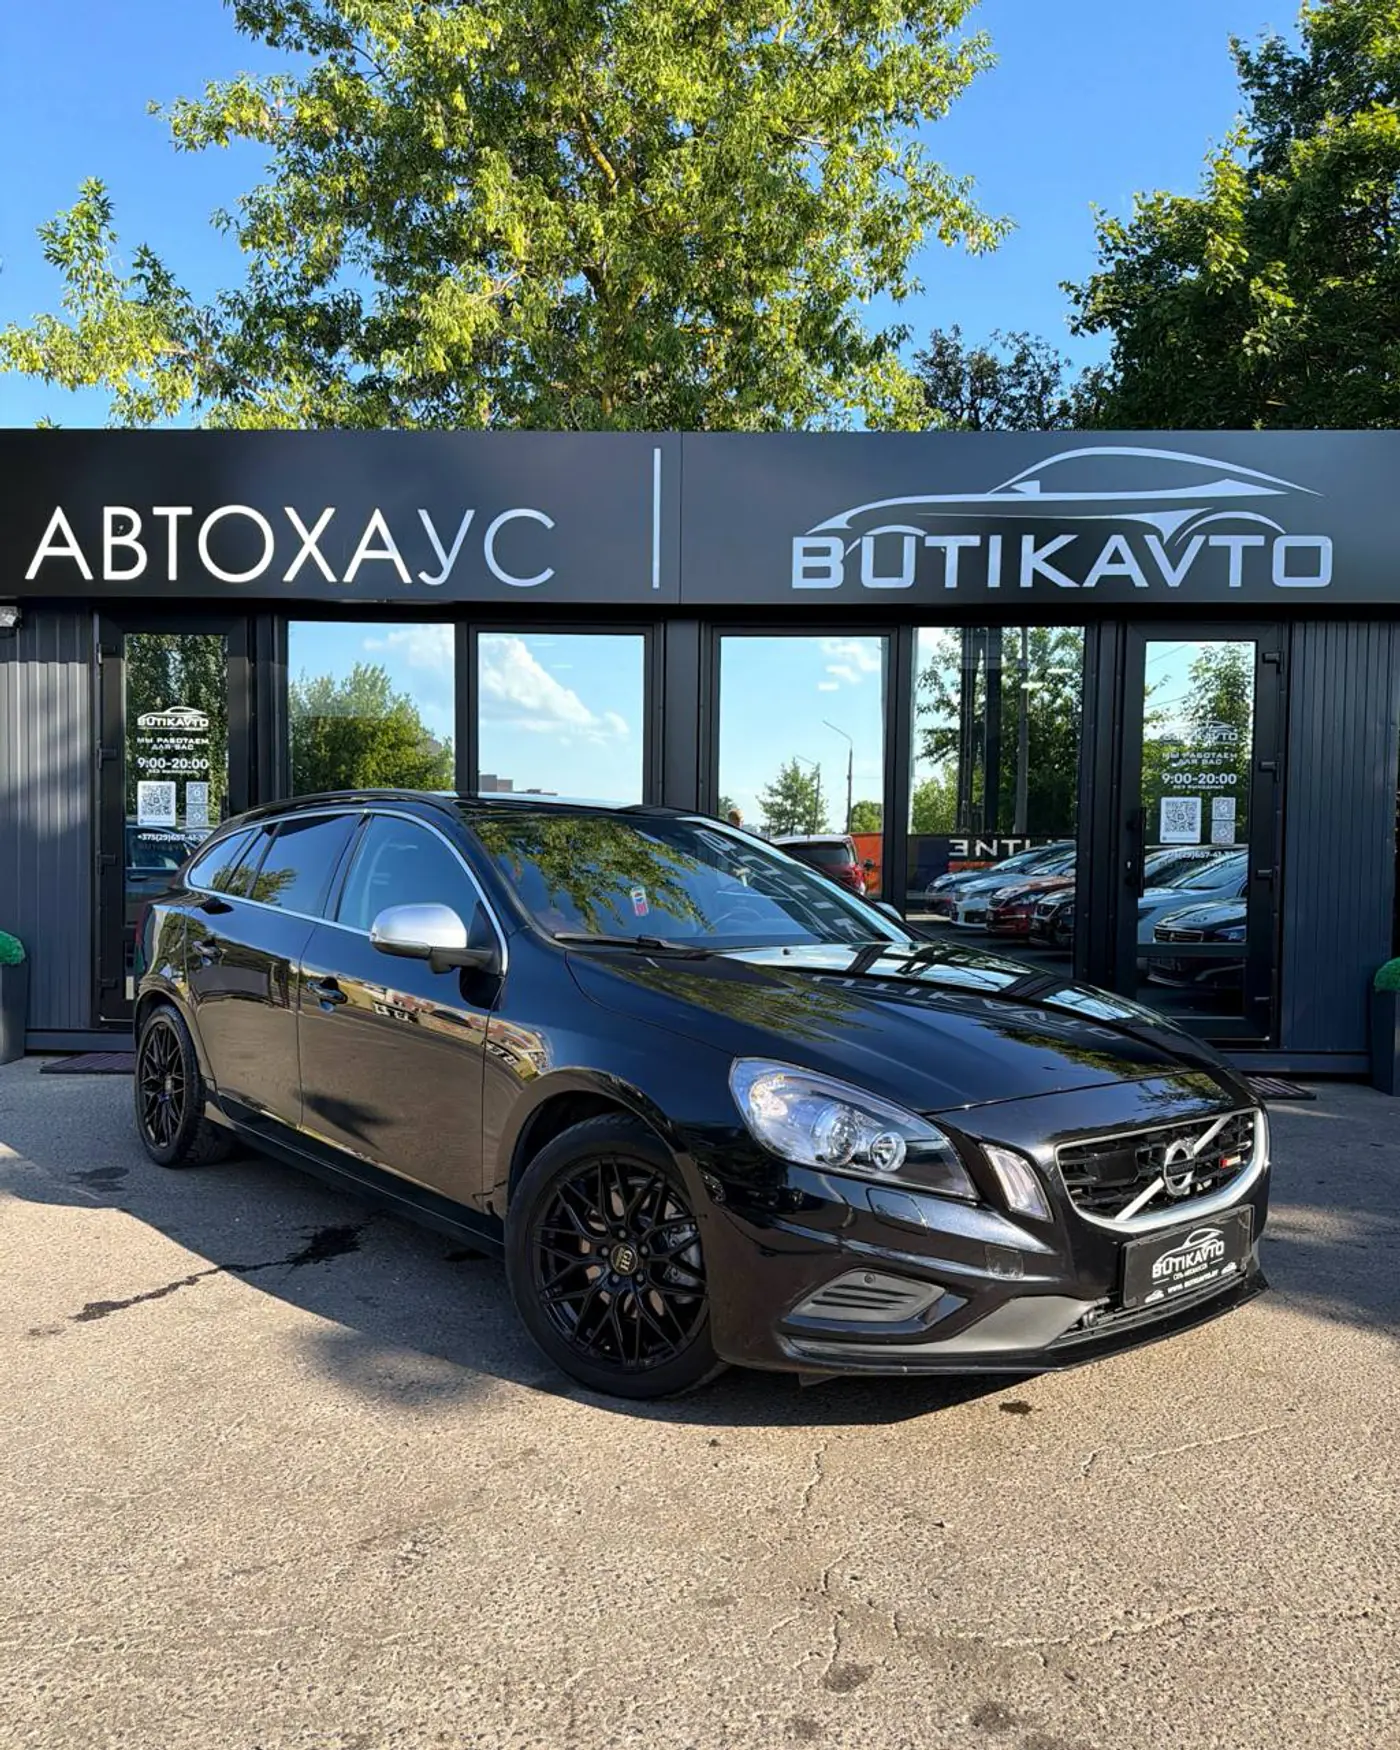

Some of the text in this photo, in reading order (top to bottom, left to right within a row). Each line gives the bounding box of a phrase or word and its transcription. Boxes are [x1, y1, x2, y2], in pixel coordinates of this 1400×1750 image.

[24, 505, 556, 587] АВТОХАУС
[791, 534, 1333, 590] BUTIKAVTO
[137, 716, 209, 727] BUTIKAVTO
[156, 737, 210, 745] РАБОТАЕМ
[137, 757, 209, 770] 9:00-20:00
[1161, 773, 1238, 785] 9:00-20:00
[1152, 1239, 1225, 1279] BUTIKAVTO
